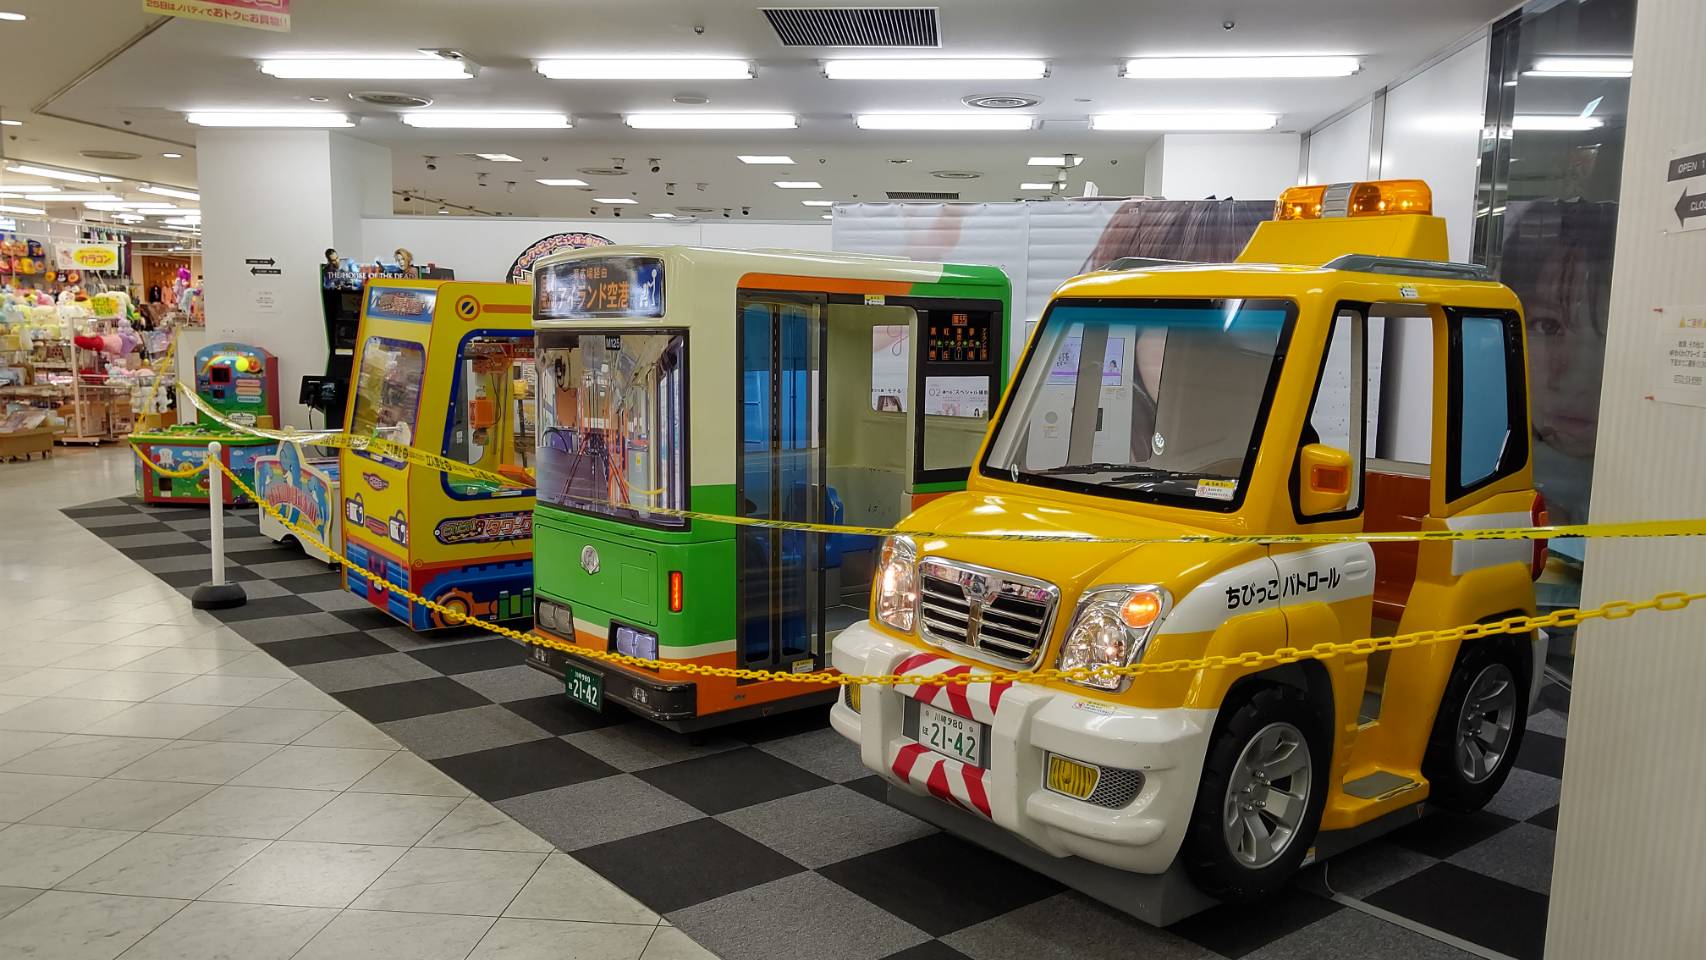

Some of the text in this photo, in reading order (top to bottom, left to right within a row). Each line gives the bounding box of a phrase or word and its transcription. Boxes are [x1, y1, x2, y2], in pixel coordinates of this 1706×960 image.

[1678, 161, 1698, 174] OPEN
[1225, 567, 1341, 610] ちびっこ パトロール
[573, 679, 598, 706] 21-42
[930, 722, 976, 761] 21-42
